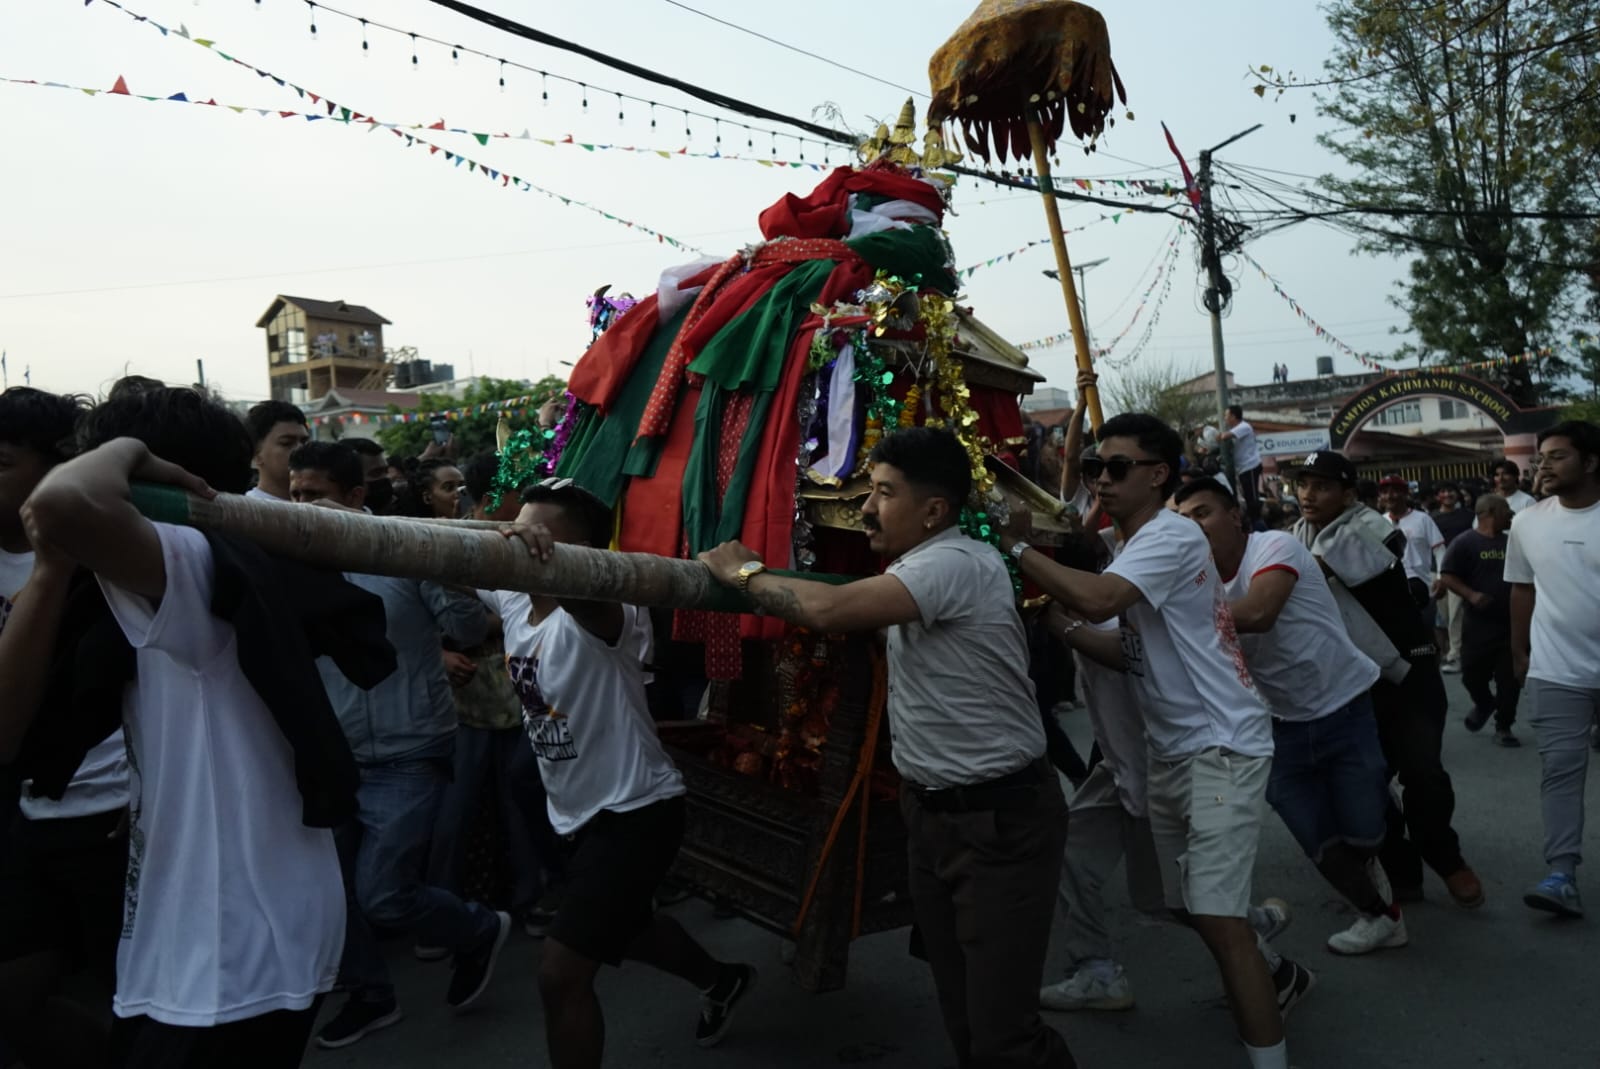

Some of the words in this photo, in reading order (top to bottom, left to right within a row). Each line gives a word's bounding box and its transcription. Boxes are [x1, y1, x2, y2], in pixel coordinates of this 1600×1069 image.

[1334, 394, 1377, 436] CAMPION
[1378, 377, 1458, 399] KATHMANDU
[1276, 438, 1324, 448] EDUCATION
[1480, 549, 1505, 560] adid
